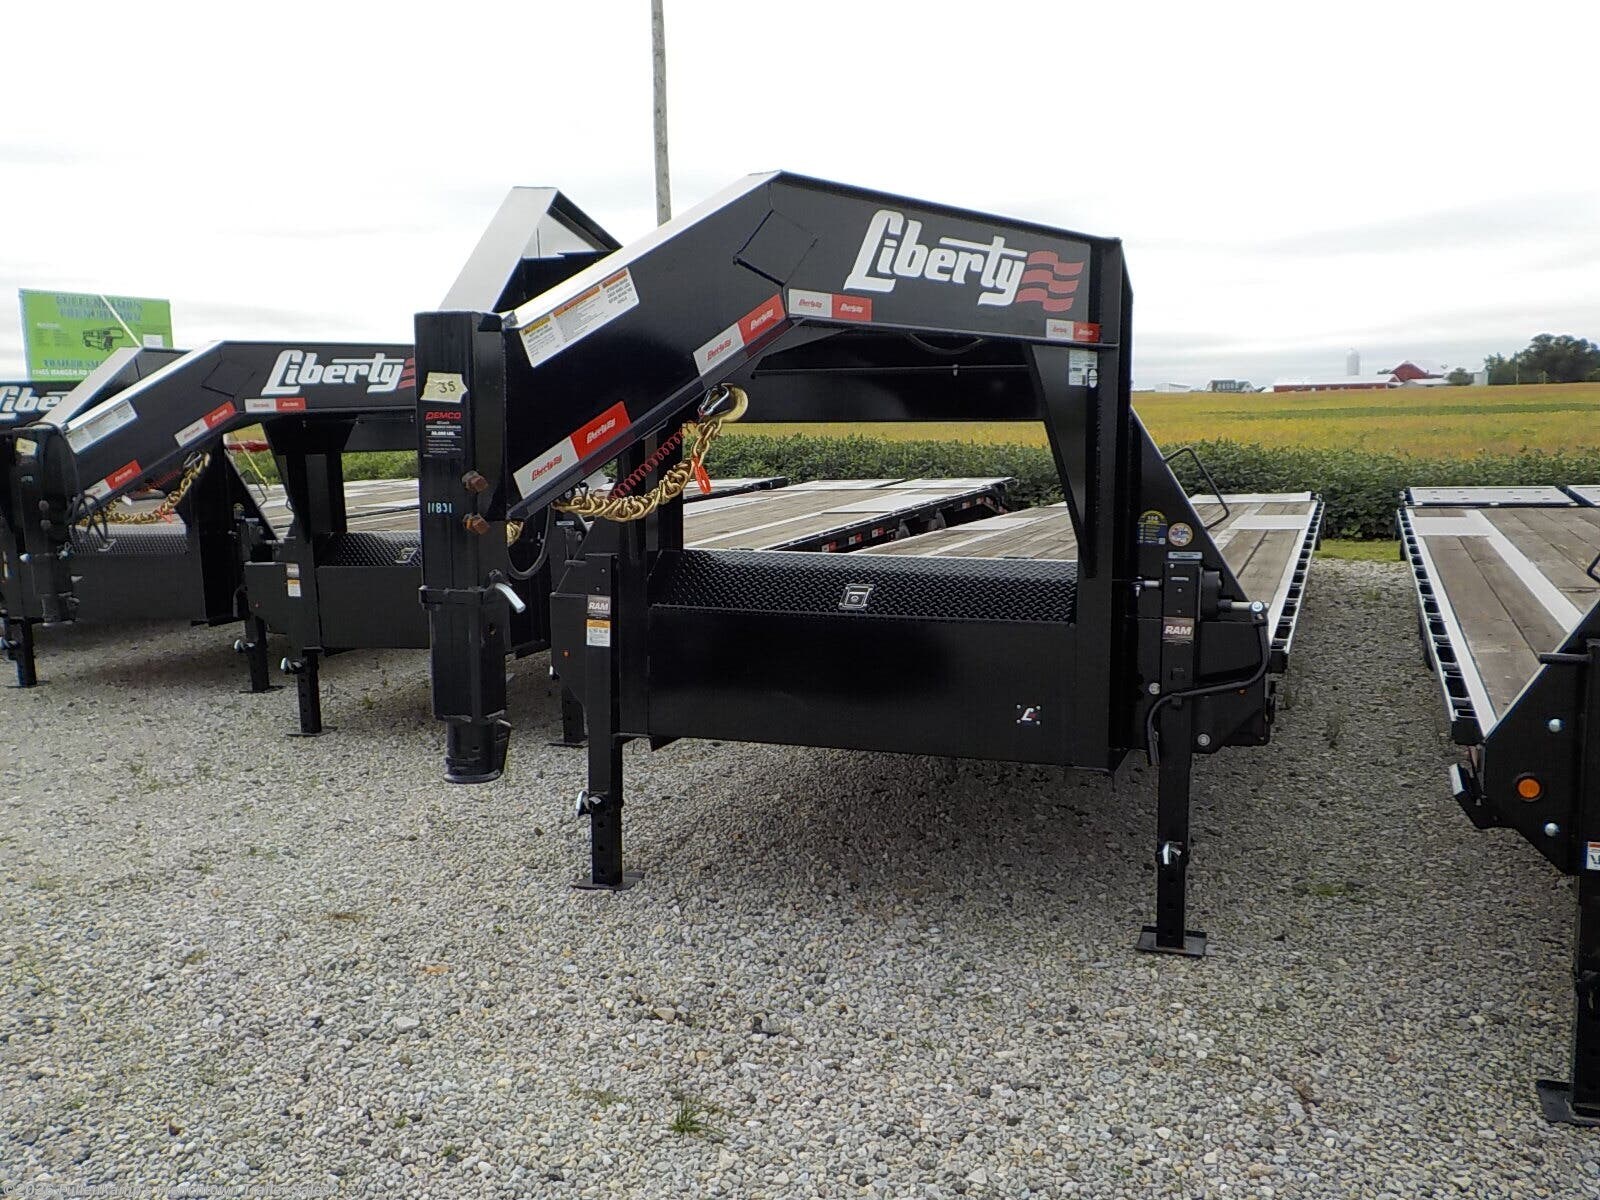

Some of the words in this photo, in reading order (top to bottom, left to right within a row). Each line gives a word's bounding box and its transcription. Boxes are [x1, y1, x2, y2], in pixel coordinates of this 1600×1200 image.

[843, 209, 1027, 306] Liberty
[260, 350, 404, 394] Liberty
[439, 380, 456, 394] 35
[425, 411, 462, 421] DEMCO
[588, 601, 609, 611] RAM
[1164, 625, 1192, 636] RAM
